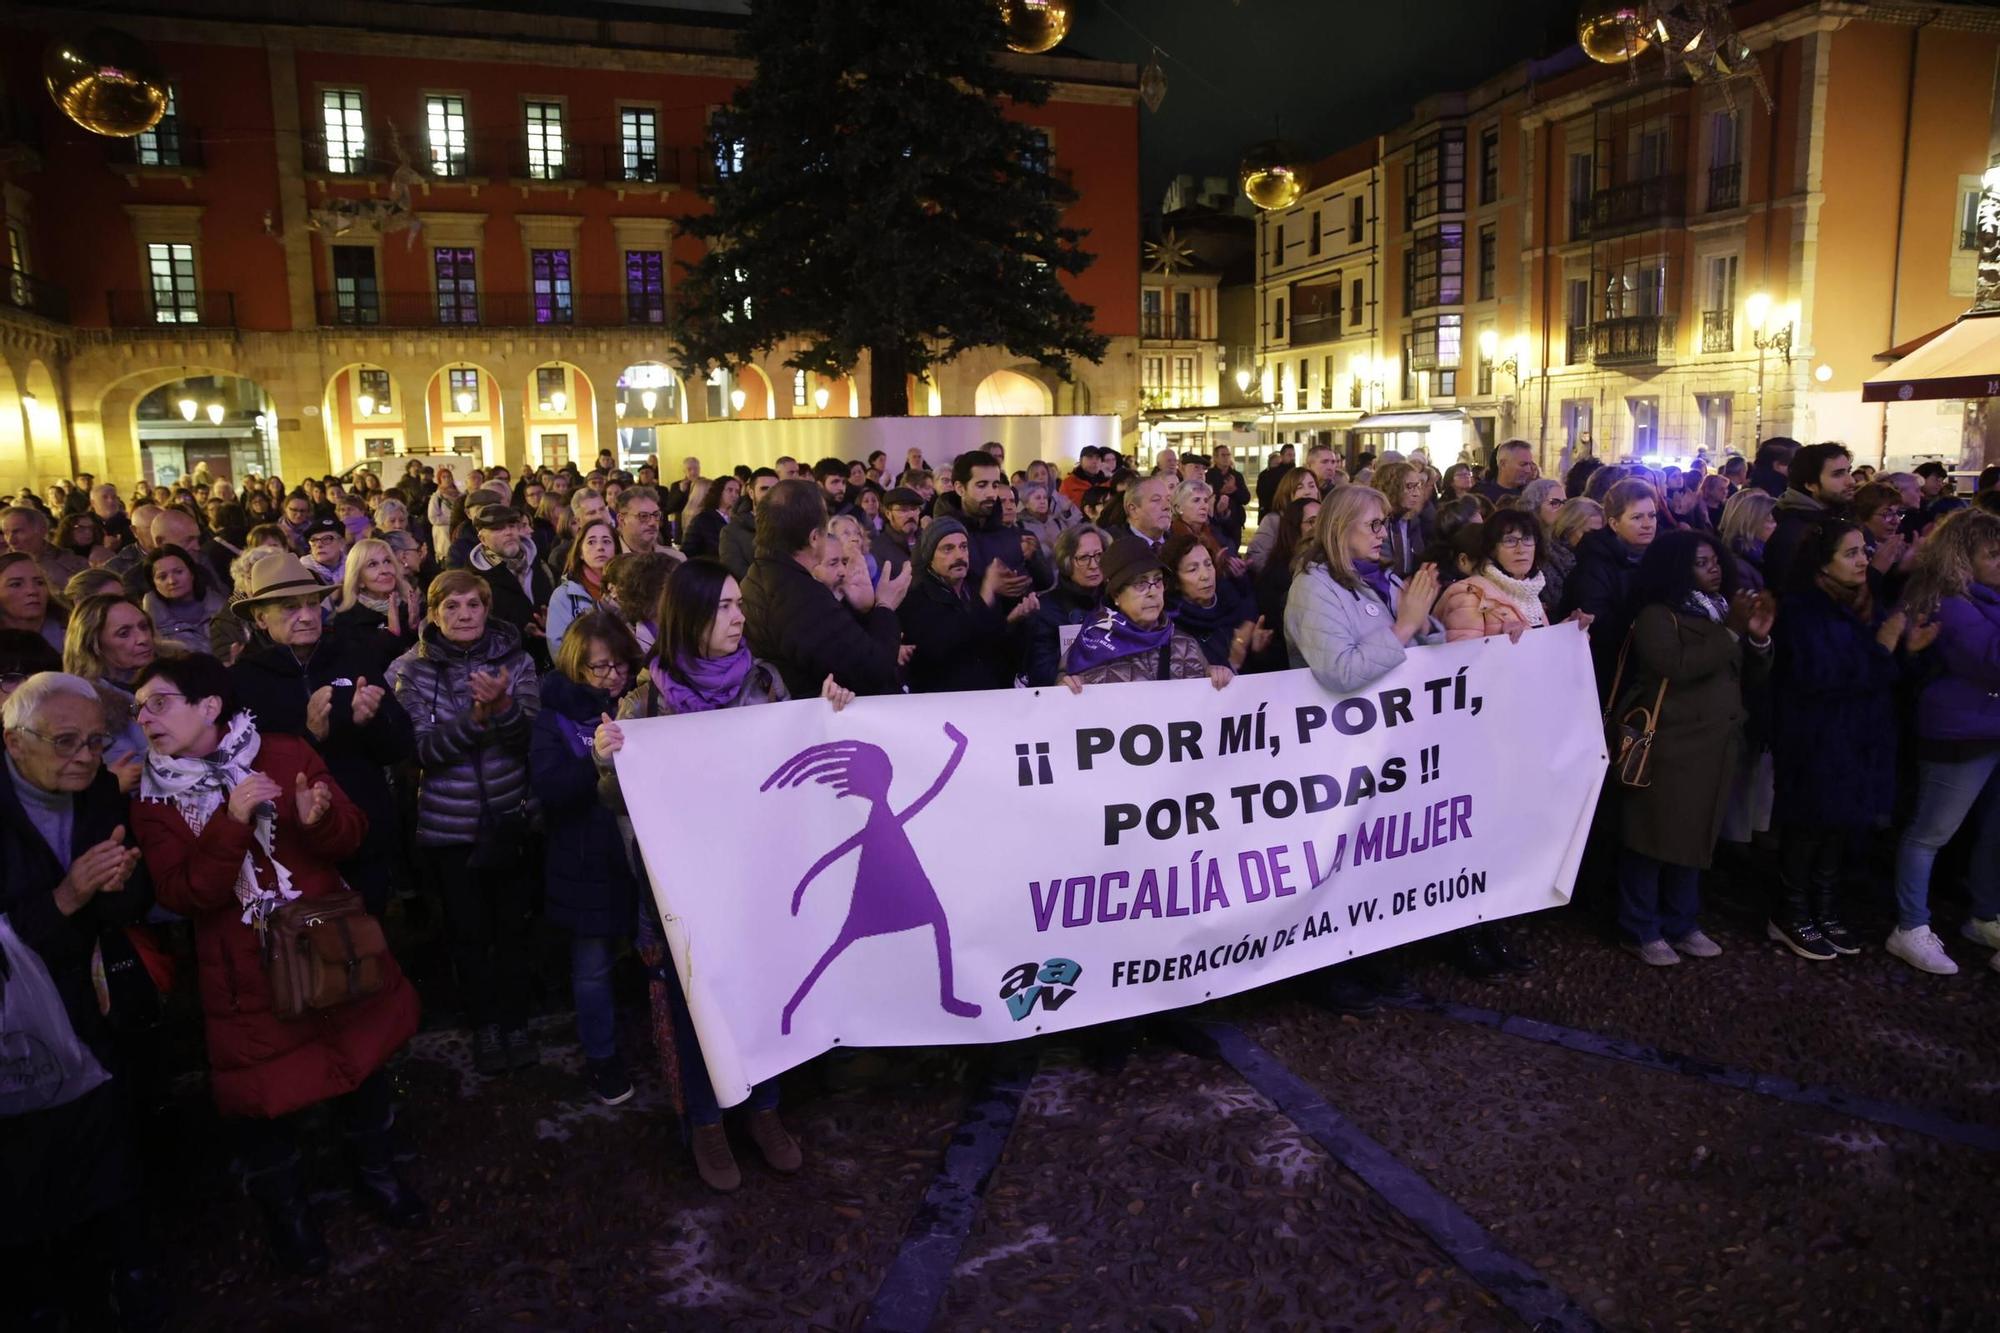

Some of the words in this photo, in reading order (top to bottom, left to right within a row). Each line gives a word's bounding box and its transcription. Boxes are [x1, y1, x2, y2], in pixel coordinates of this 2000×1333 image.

[1076, 720, 1203, 770] POR
[1218, 702, 1281, 757] MÍ,
[1296, 688, 1413, 744] POR
[1424, 666, 1484, 717] TÍ,
[1103, 792, 1219, 846] POR
[1231, 757, 1406, 824] TODAS
[1029, 849, 1230, 932] VOCALÍA
[1239, 845, 1296, 904] DE
[1354, 794, 1474, 867] MUJER
[1111, 931, 1268, 988] FEDERACIÓN
[1272, 924, 1299, 949] DE
[1303, 918, 1339, 942] AA.
[1348, 899, 1385, 928] VV.
[1393, 889, 1418, 916] DE
[1424, 868, 1488, 908] GIJÓN
